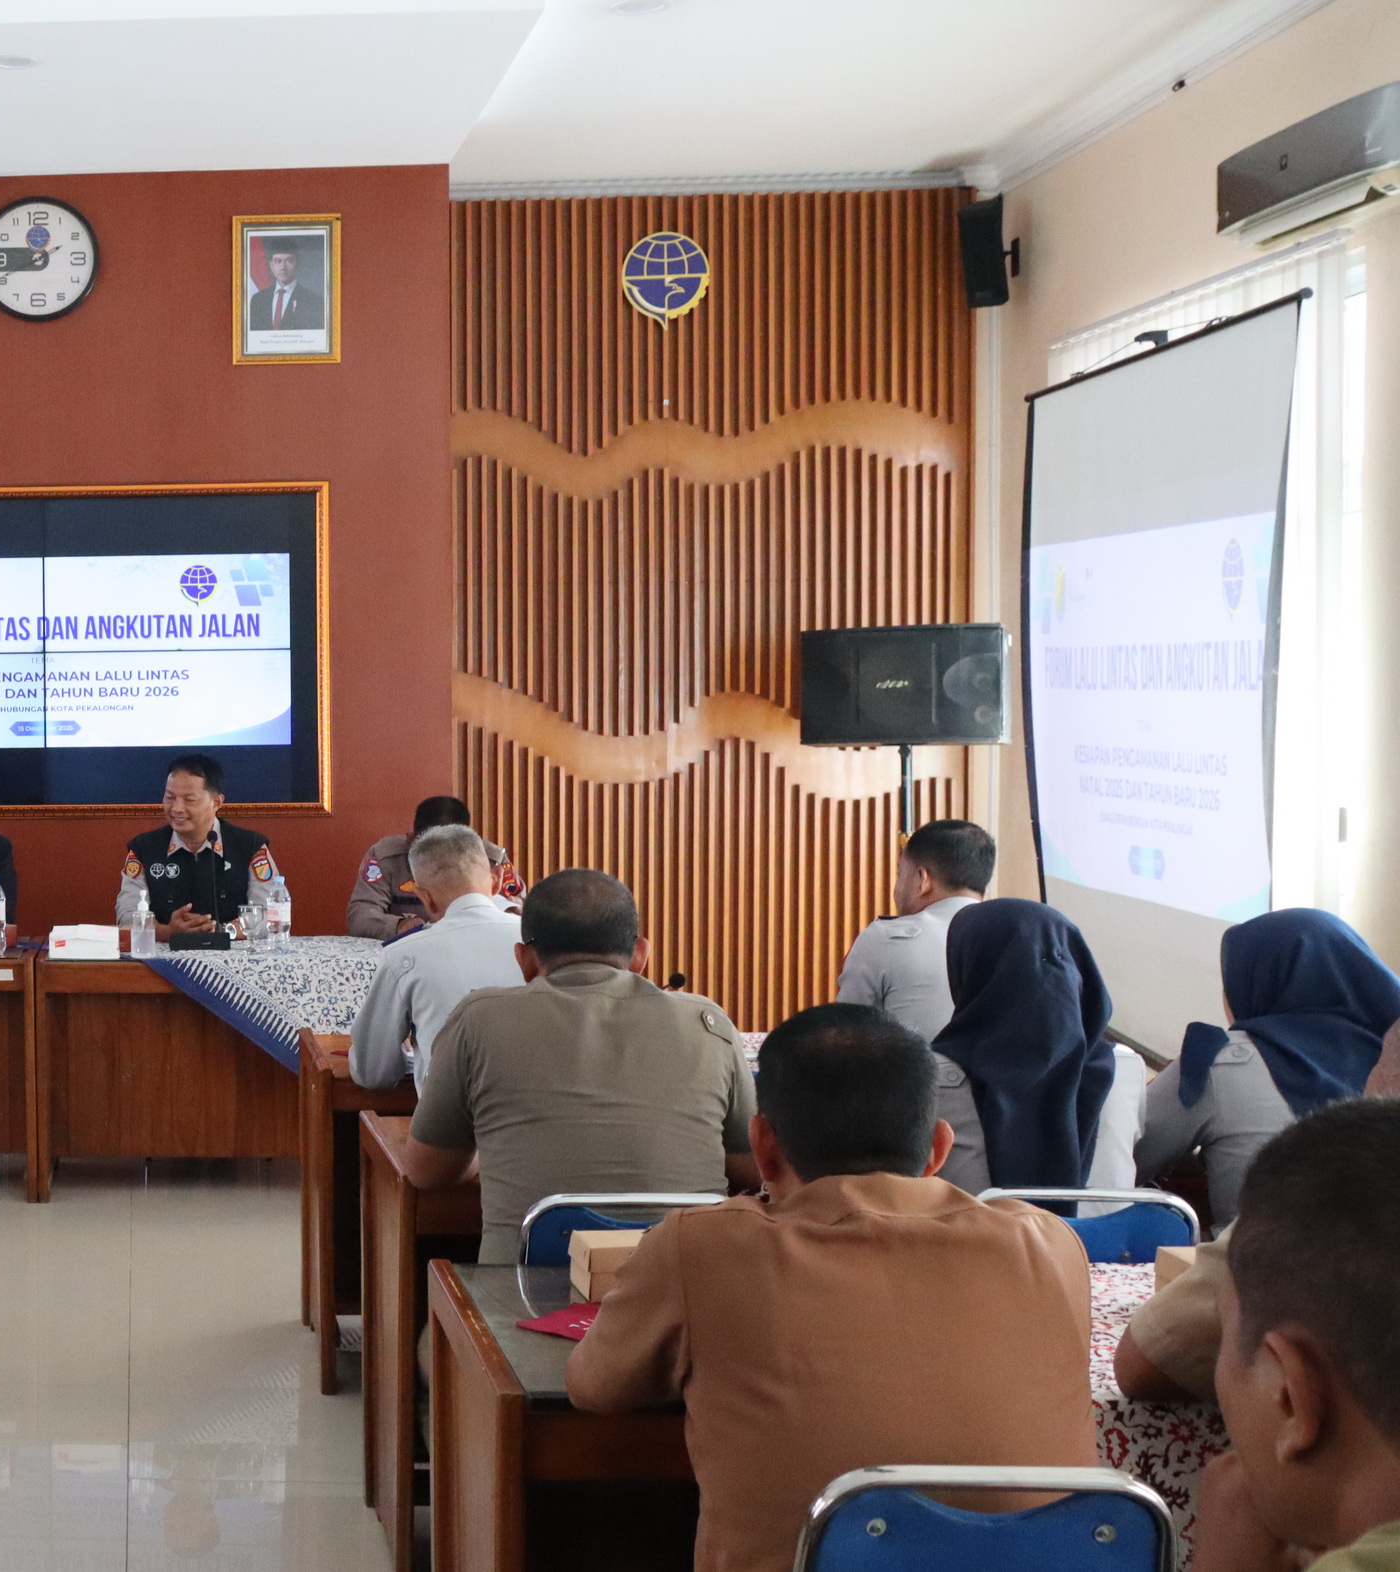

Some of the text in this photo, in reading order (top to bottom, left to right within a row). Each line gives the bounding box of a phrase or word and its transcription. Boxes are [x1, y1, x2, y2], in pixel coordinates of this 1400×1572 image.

[12, 218, 19, 226] 11
[27, 211, 49, 226] 12
[71, 232, 79, 240] 2
[70, 252, 86, 266] 3
[12, 293, 19, 301] 7
[30, 293, 46, 307] 6
[57, 293, 65, 301] 5
[36, 616, 78, 640] DAN
[84, 614, 192, 640] ANGKUTAN
[198, 613, 260, 638] JALAN
[1044, 638, 1263, 692] FORUM LALU LINTAS DAN ANGKUTAN JALA
[95, 670, 132, 681] LALU
[137, 669, 190, 680] LINTAS
[5, 688, 37, 699] DAN
[42, 687, 93, 698] TAHUN
[98, 686, 140, 697] BARU
[144, 686, 179, 697] 2026
[76, 704, 134, 712] PEKALONGAN
[1074, 744, 1228, 777] KESIAPAN PENGAMANAN LALU LINTAS
[1079, 775, 1221, 812] NATAL 2025 DAN TAHUN BARU 2026
